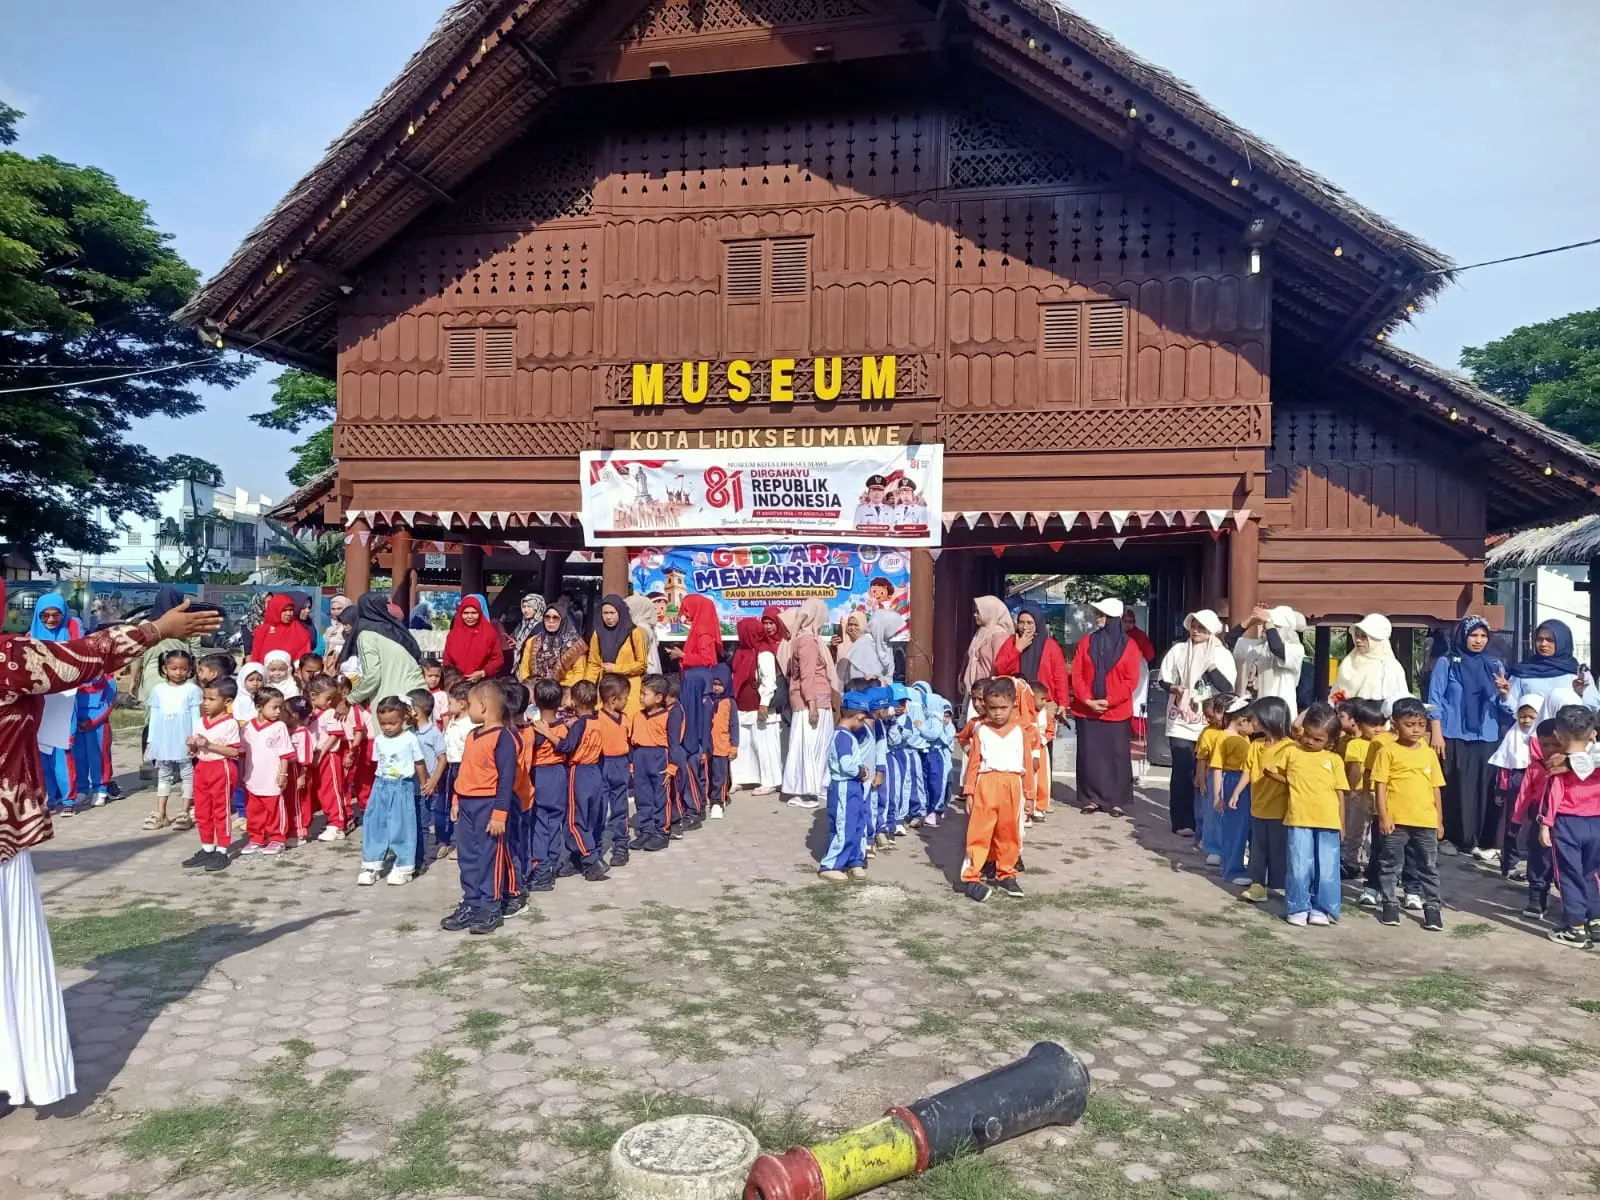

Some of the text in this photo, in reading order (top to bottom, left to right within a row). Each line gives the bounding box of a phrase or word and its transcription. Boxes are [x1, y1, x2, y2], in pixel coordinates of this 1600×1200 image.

[632, 355, 897, 406] MUSEUM
[630, 425, 901, 450] KOTA LHOKSEUMAWE
[750, 469, 810, 478] DIRGAHAYU
[703, 465, 744, 514] 81
[751, 478, 829, 493] REPUBLIK
[753, 493, 843, 508] INDONESIA
[711, 544, 830, 567] GEBYAR
[695, 565, 854, 592] MEWARNAI
[725, 589, 834, 598] PAUD (KELOMPOK BERMAIN)
